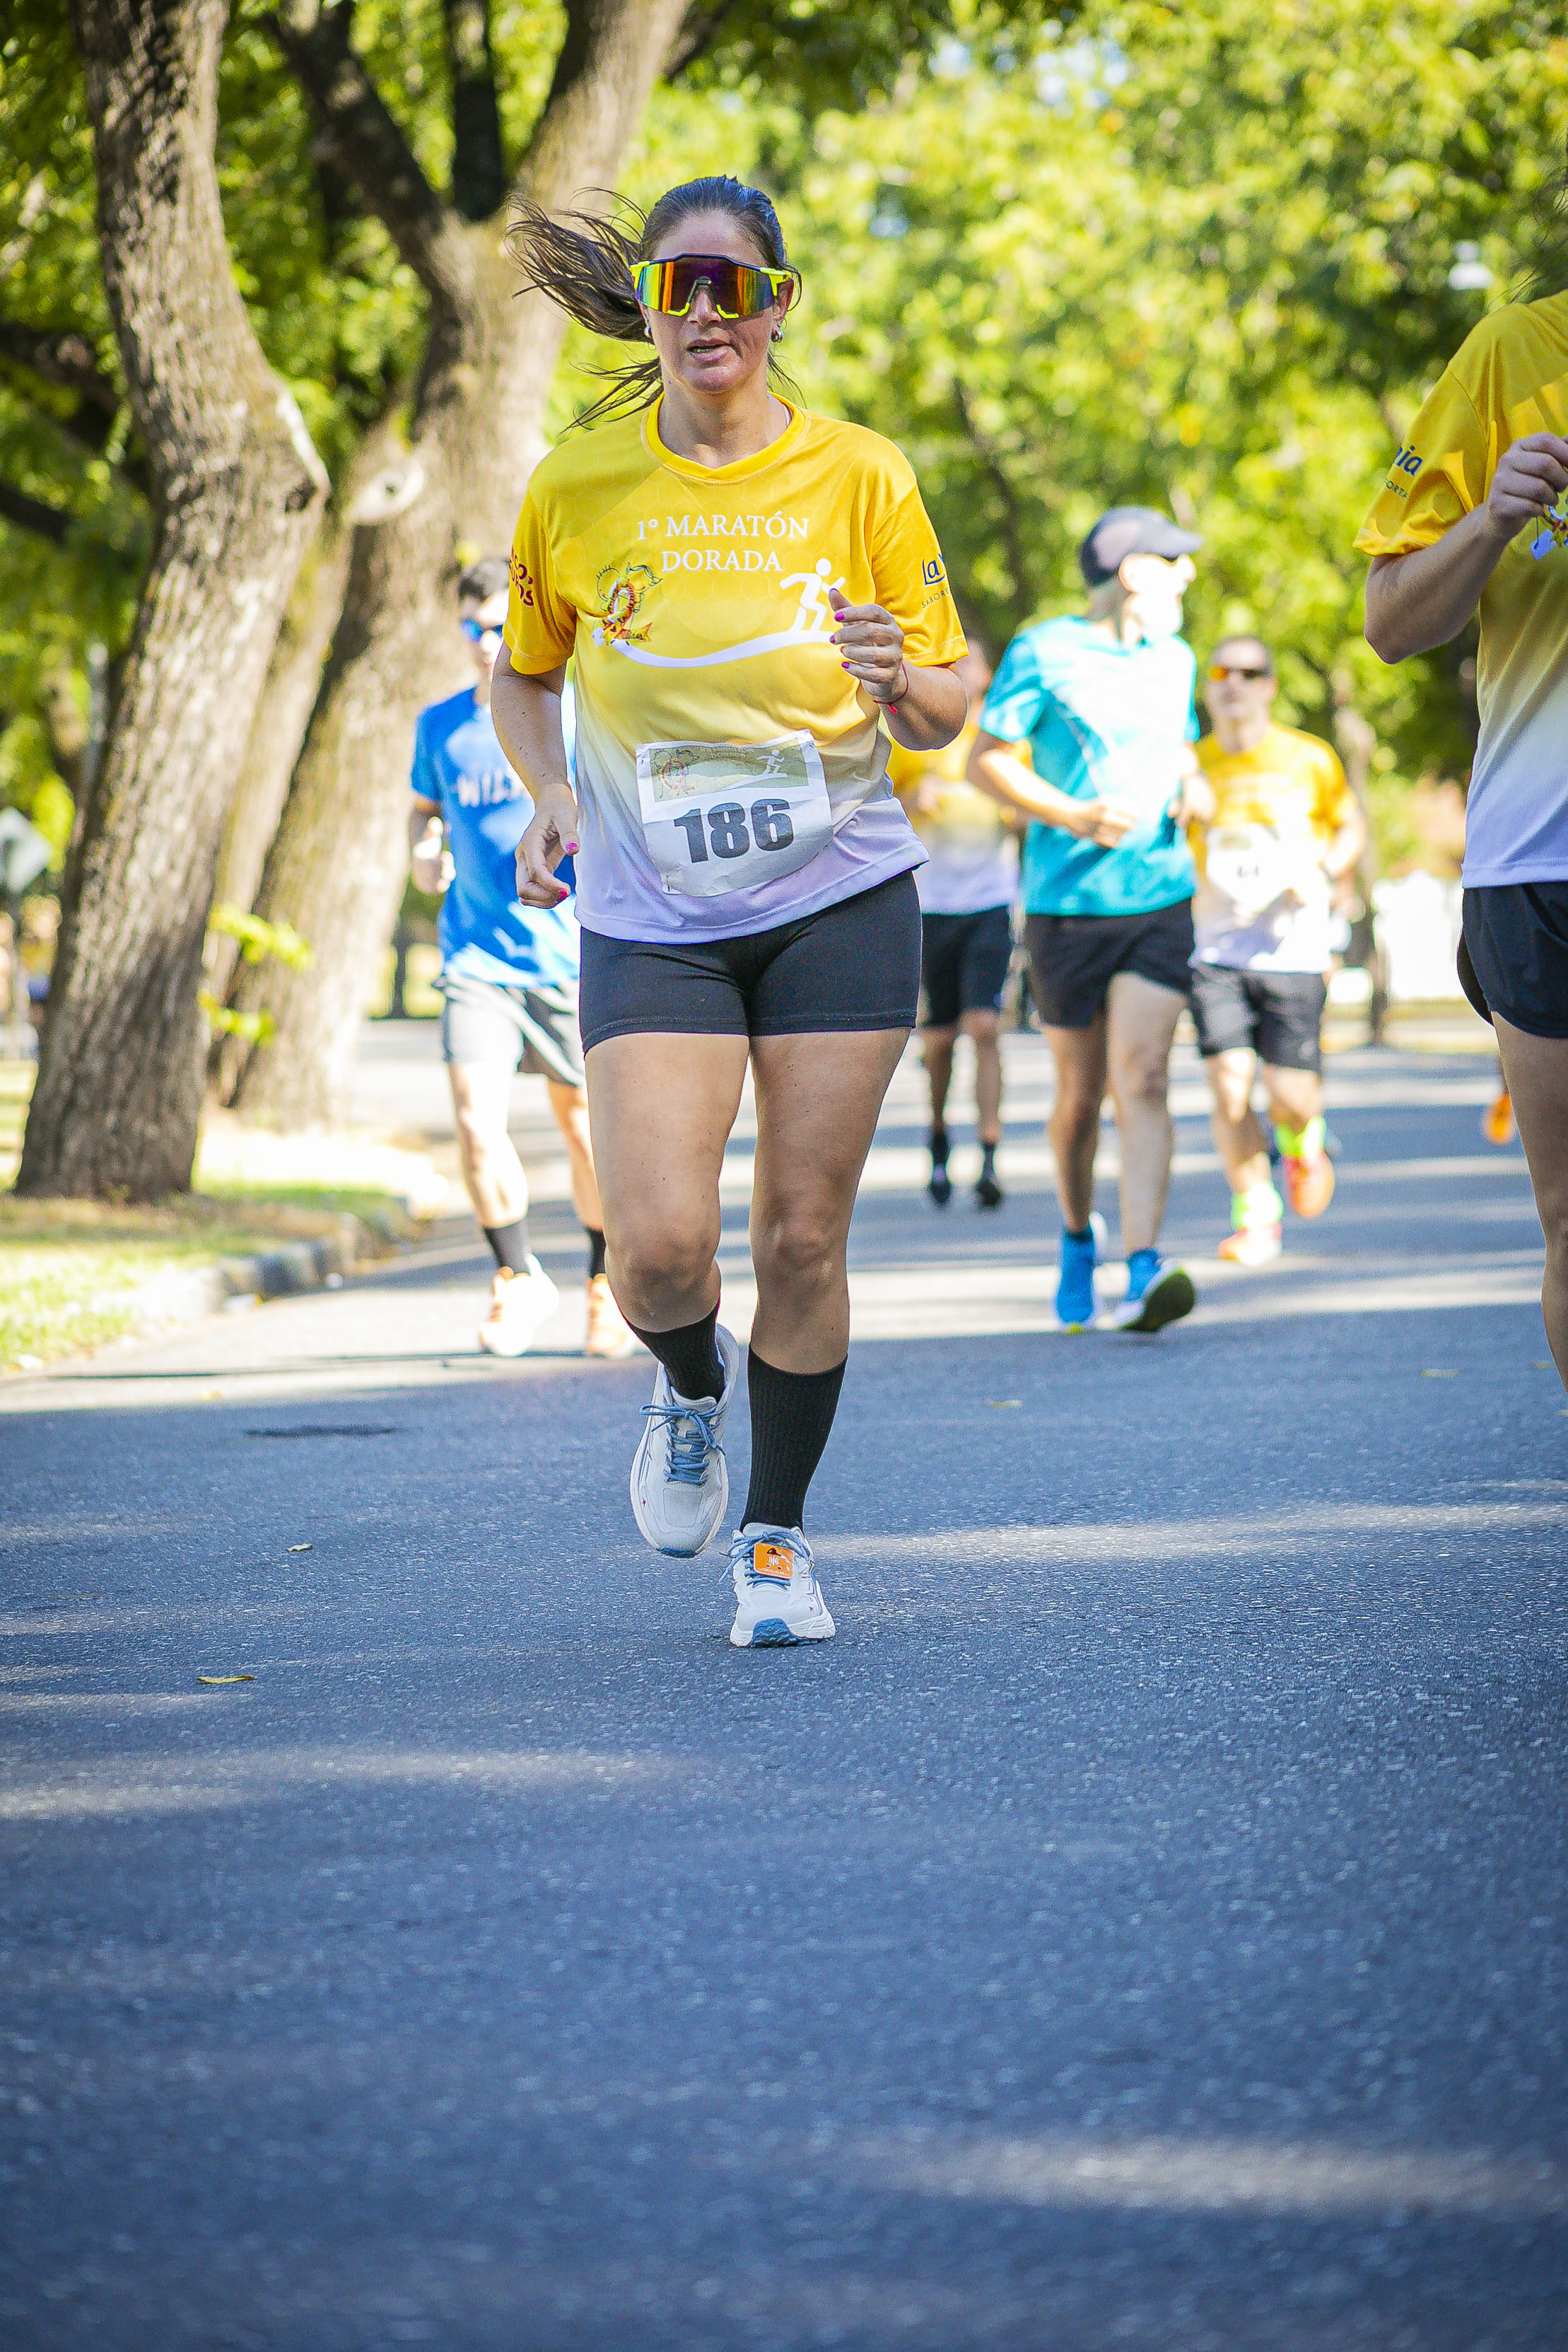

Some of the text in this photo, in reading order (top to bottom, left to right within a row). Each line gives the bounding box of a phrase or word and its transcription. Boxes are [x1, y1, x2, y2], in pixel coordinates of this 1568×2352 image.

[665, 510, 809, 539] MARATÓN
[660, 549, 783, 572] DORADA
[674, 798, 794, 863] 186
